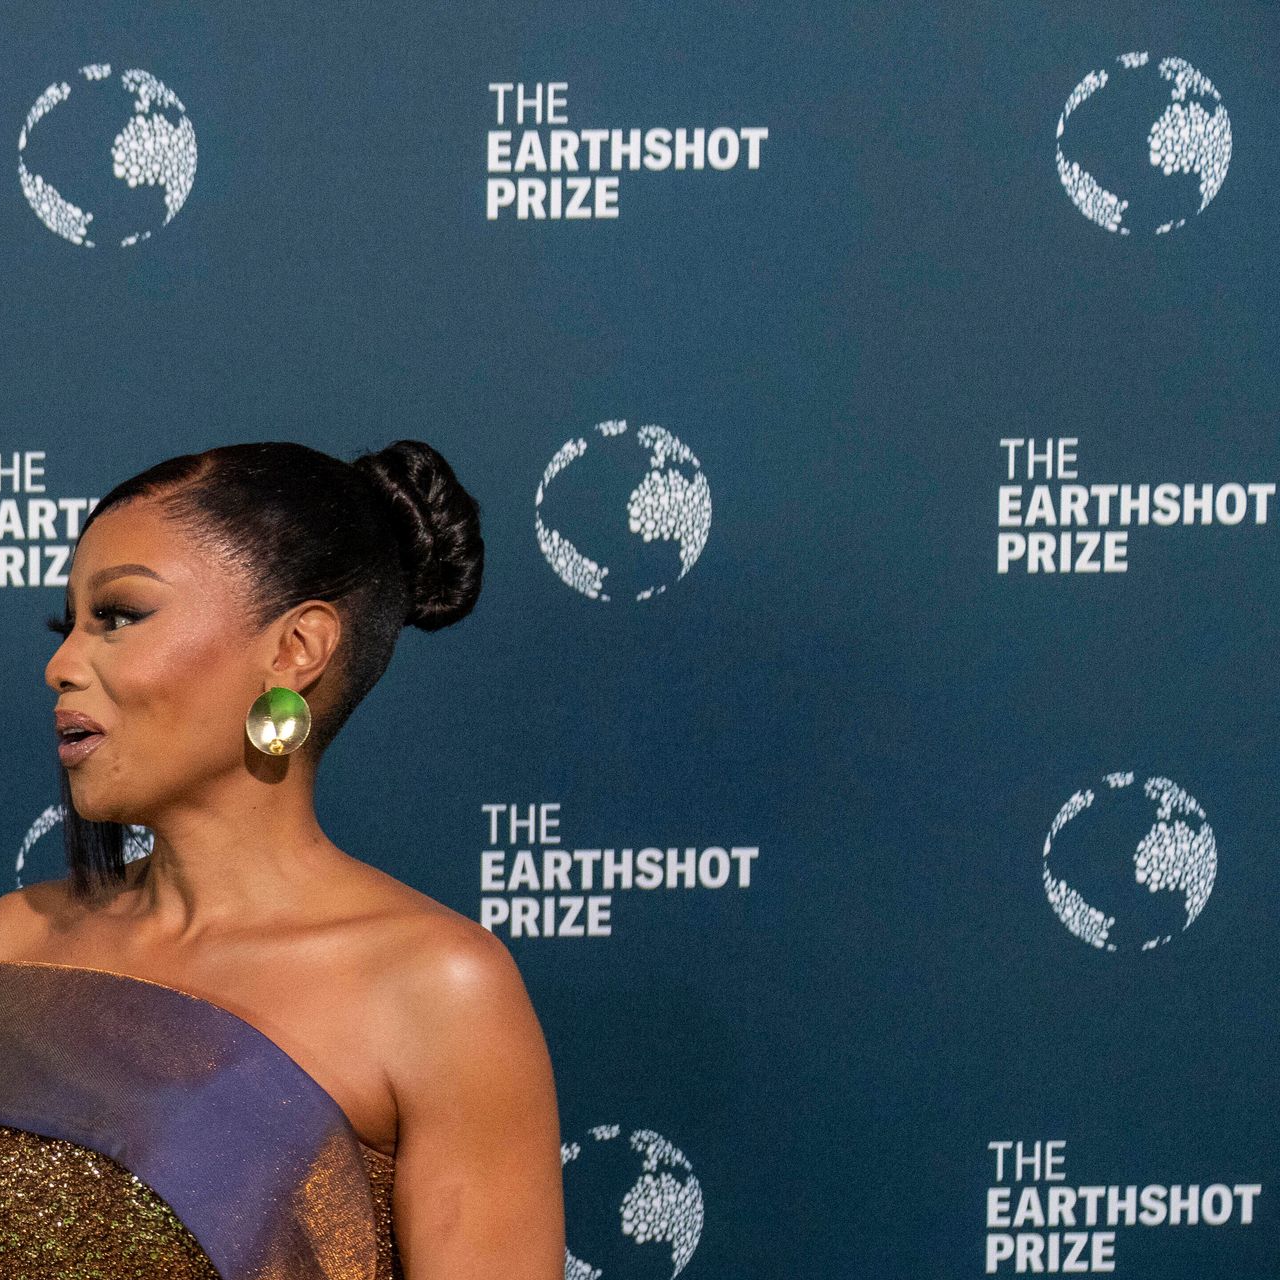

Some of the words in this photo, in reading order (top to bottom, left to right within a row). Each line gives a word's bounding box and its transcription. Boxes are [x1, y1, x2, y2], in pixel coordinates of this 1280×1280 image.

[488, 82, 569, 125] THE
[487, 127, 769, 173] EARTHSHOT
[486, 176, 620, 220] PRIZE
[999, 437, 1079, 480] THE
[998, 482, 1276, 527] EARTHSHOT
[997, 531, 1129, 574] PRIZE
[481, 803, 561, 845] THE
[480, 846, 760, 891] EARTHSHOT
[480, 895, 612, 938] PRIZE
[987, 1140, 1067, 1182] THE
[986, 1183, 1262, 1228] EARTHSHOT
[985, 1231, 1116, 1274] PRIZE
